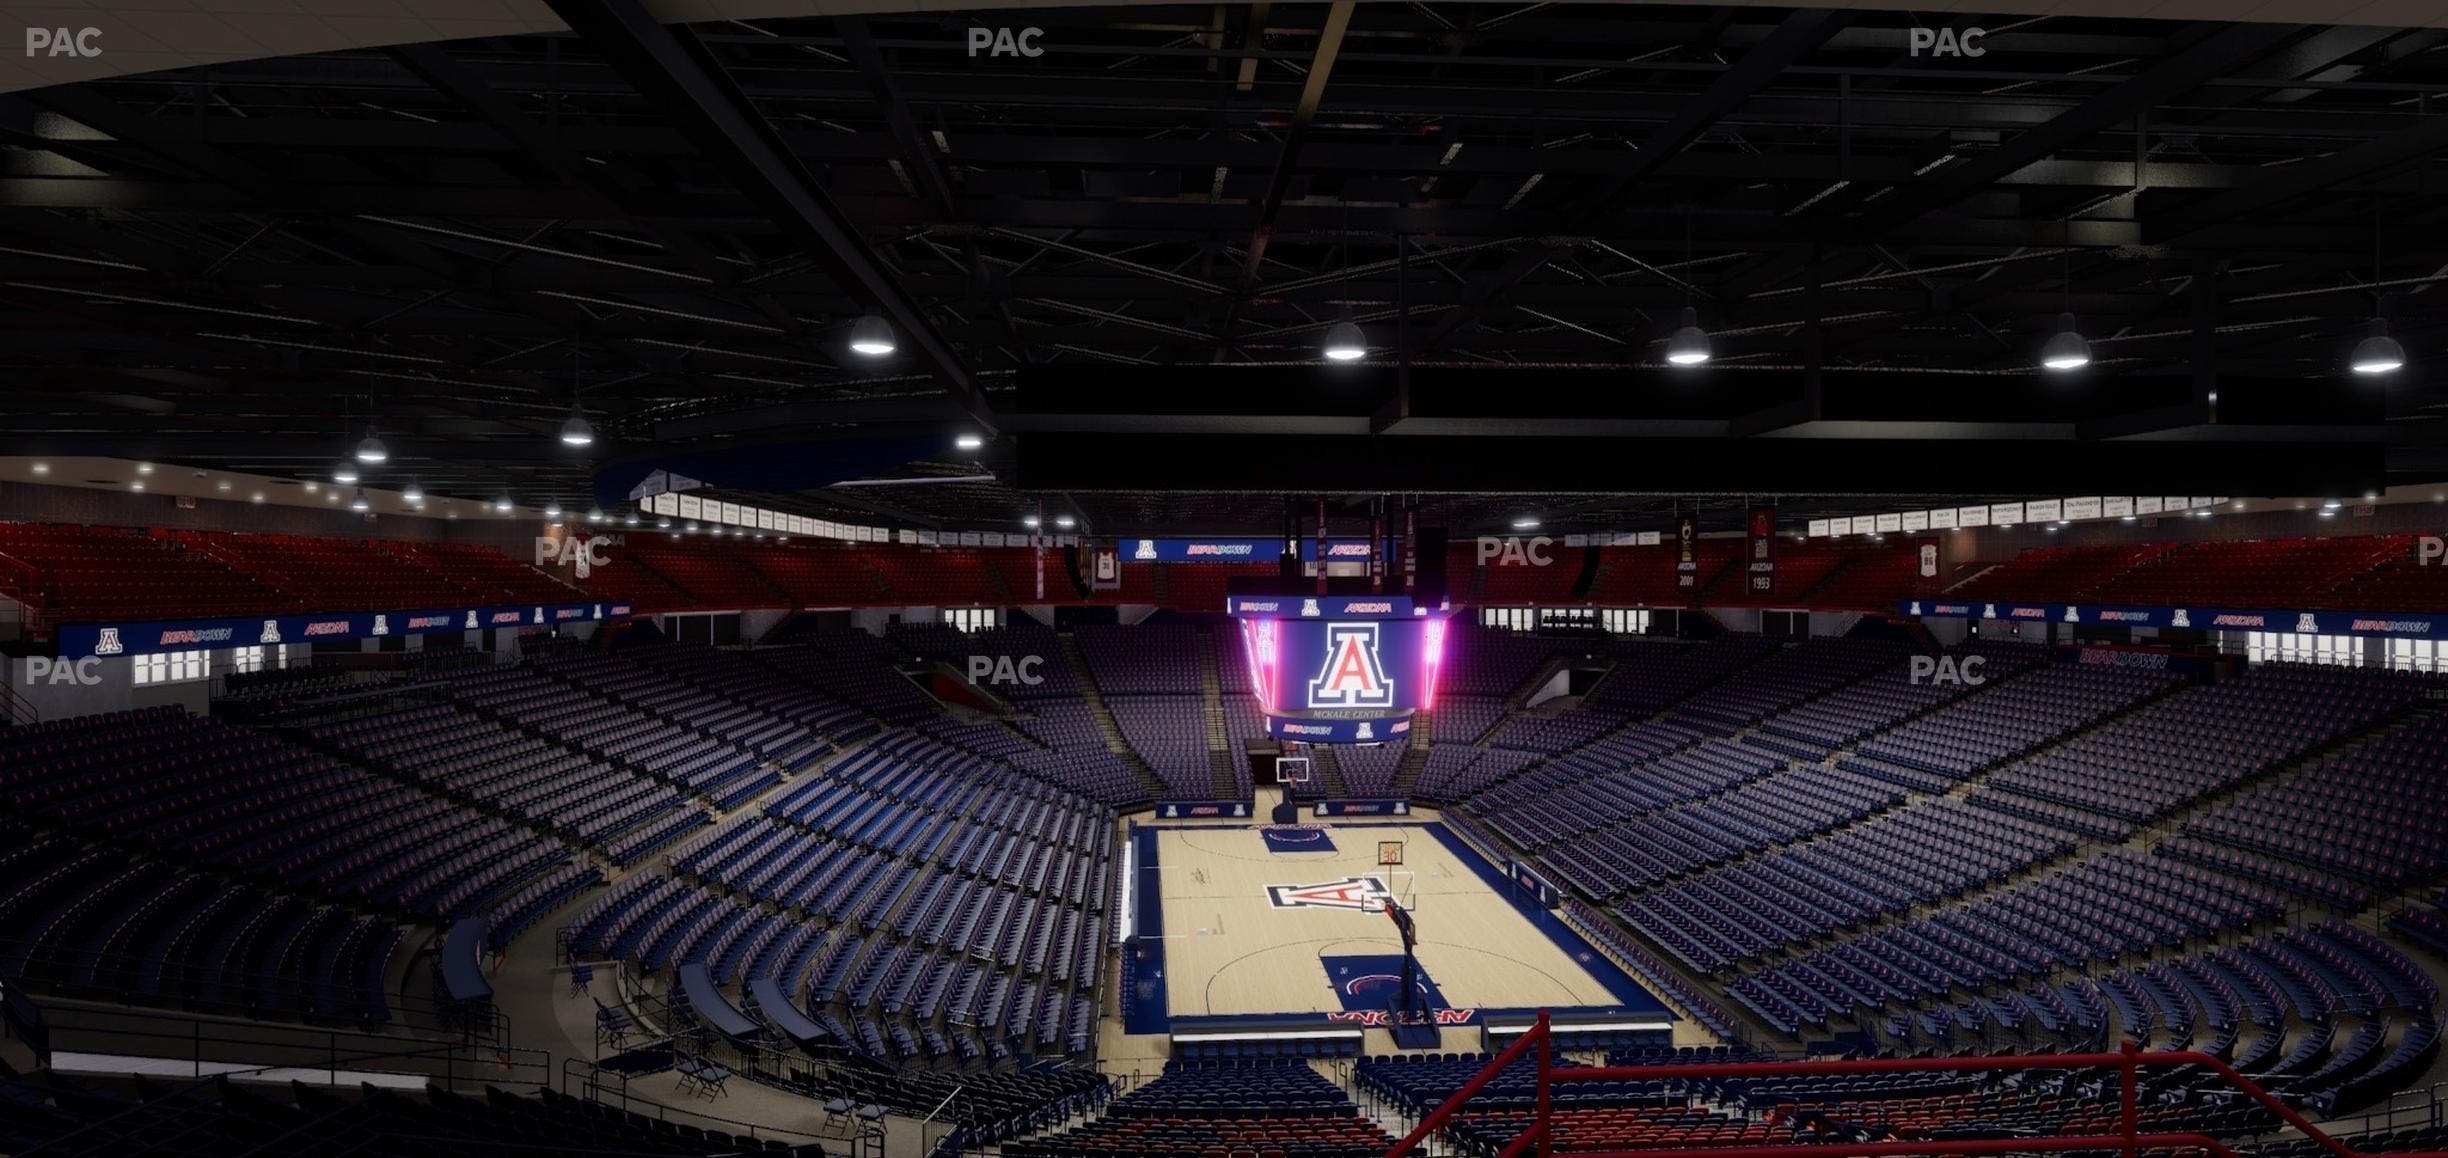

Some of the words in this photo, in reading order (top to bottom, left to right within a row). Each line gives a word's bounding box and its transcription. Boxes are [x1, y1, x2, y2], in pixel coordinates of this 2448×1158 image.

[1752, 576, 1771, 590] 1993
[2296, 613, 2319, 633] A
[95, 628, 123, 655] A
[260, 619, 281, 643] A
[1308, 622, 1394, 708] A
[1353, 709, 1386, 719] CENTER
